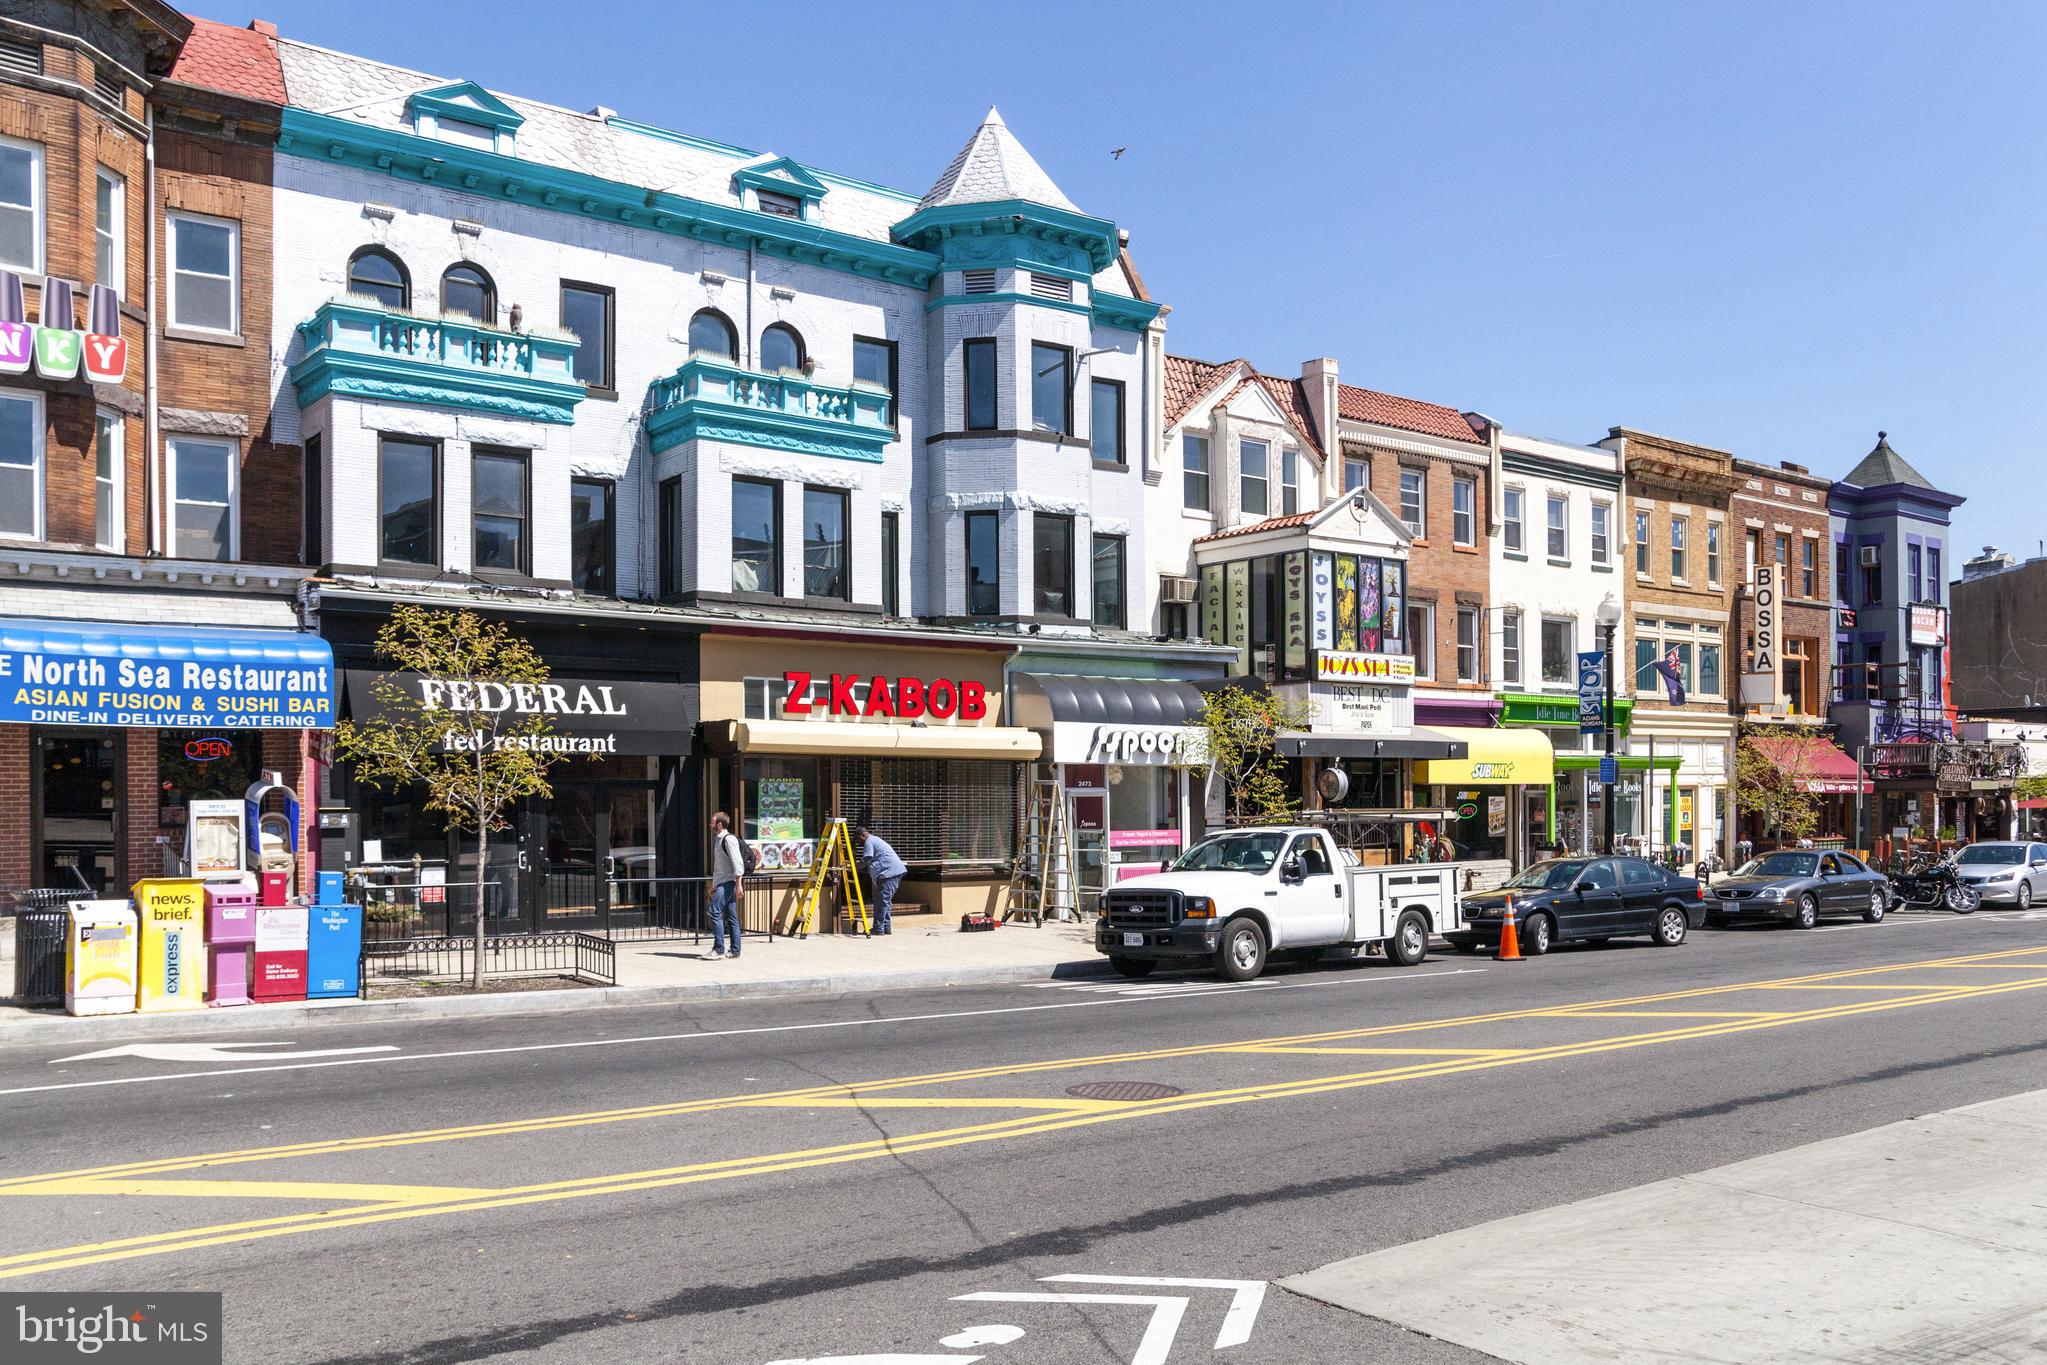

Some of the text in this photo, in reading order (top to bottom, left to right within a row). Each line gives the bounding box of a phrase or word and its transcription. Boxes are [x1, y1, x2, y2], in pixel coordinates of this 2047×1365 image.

[1233, 568, 1245, 642] WAXXING
[1757, 568, 1773, 670] BOSSA
[24, 655, 106, 688] North
[118, 662, 171, 690] Sea
[183, 662, 328, 693] Restaurant
[783, 671, 987, 721] Z-KABOB
[1333, 685, 1363, 702] BEST
[1581, 659, 1602, 714] SHOP
[14, 689, 330, 714] ASIAN FUSION & SUSHI BAR
[417, 678, 627, 716] FEDERAL
[1355, 703, 1369, 711] Mani
[1536, 705, 1551, 719] Idle
[1552, 705, 1570, 720] Time
[31, 709, 317, 728] DINE-IN DELIVERY CATERING
[185, 741, 231, 757] OPEN
[444, 729, 617, 753] fed restaurant
[1471, 762, 1514, 779] SUBWAY
[1588, 779, 1602, 795] Idle
[1624, 780, 1642, 795] Books
[1460, 807, 1475, 815] OPEN
[151, 894, 195, 905] news.
[154, 907, 193, 921] brief.
[167, 934, 180, 994] express
